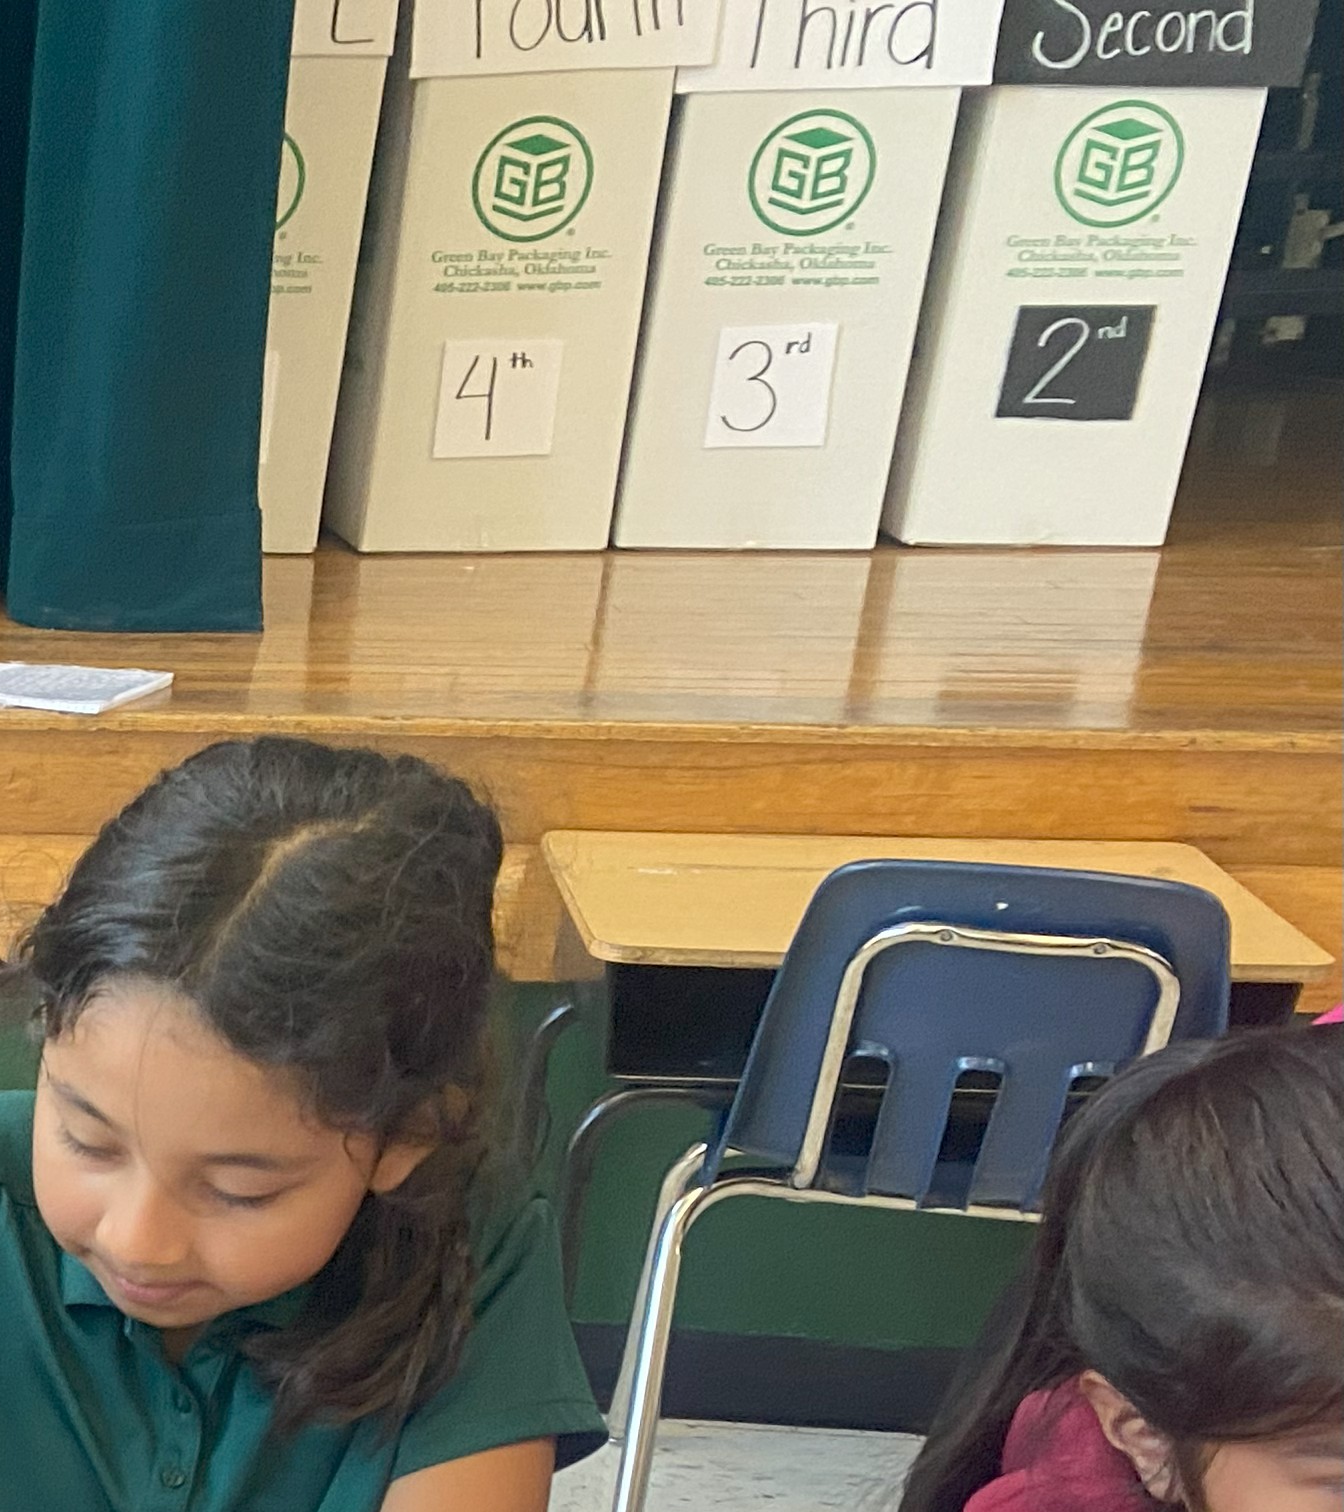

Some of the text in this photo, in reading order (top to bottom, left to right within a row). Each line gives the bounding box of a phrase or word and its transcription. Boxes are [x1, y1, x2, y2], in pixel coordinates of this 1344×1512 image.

[1031, 0, 1254, 70] Second
[494, 153, 571, 208] GB
[771, 147, 854, 200] GB
[1077, 138, 1162, 192] GB
[431, 247, 612, 264] Green Bay Packaging Inc.
[703, 243, 747, 256] Green
[750, 243, 780, 258] Bay
[783, 242, 861, 257] Packaging
[720, 331, 812, 432] 3rd
[1022, 315, 1129, 405] 2nd
[455, 352, 535, 441] 4th
